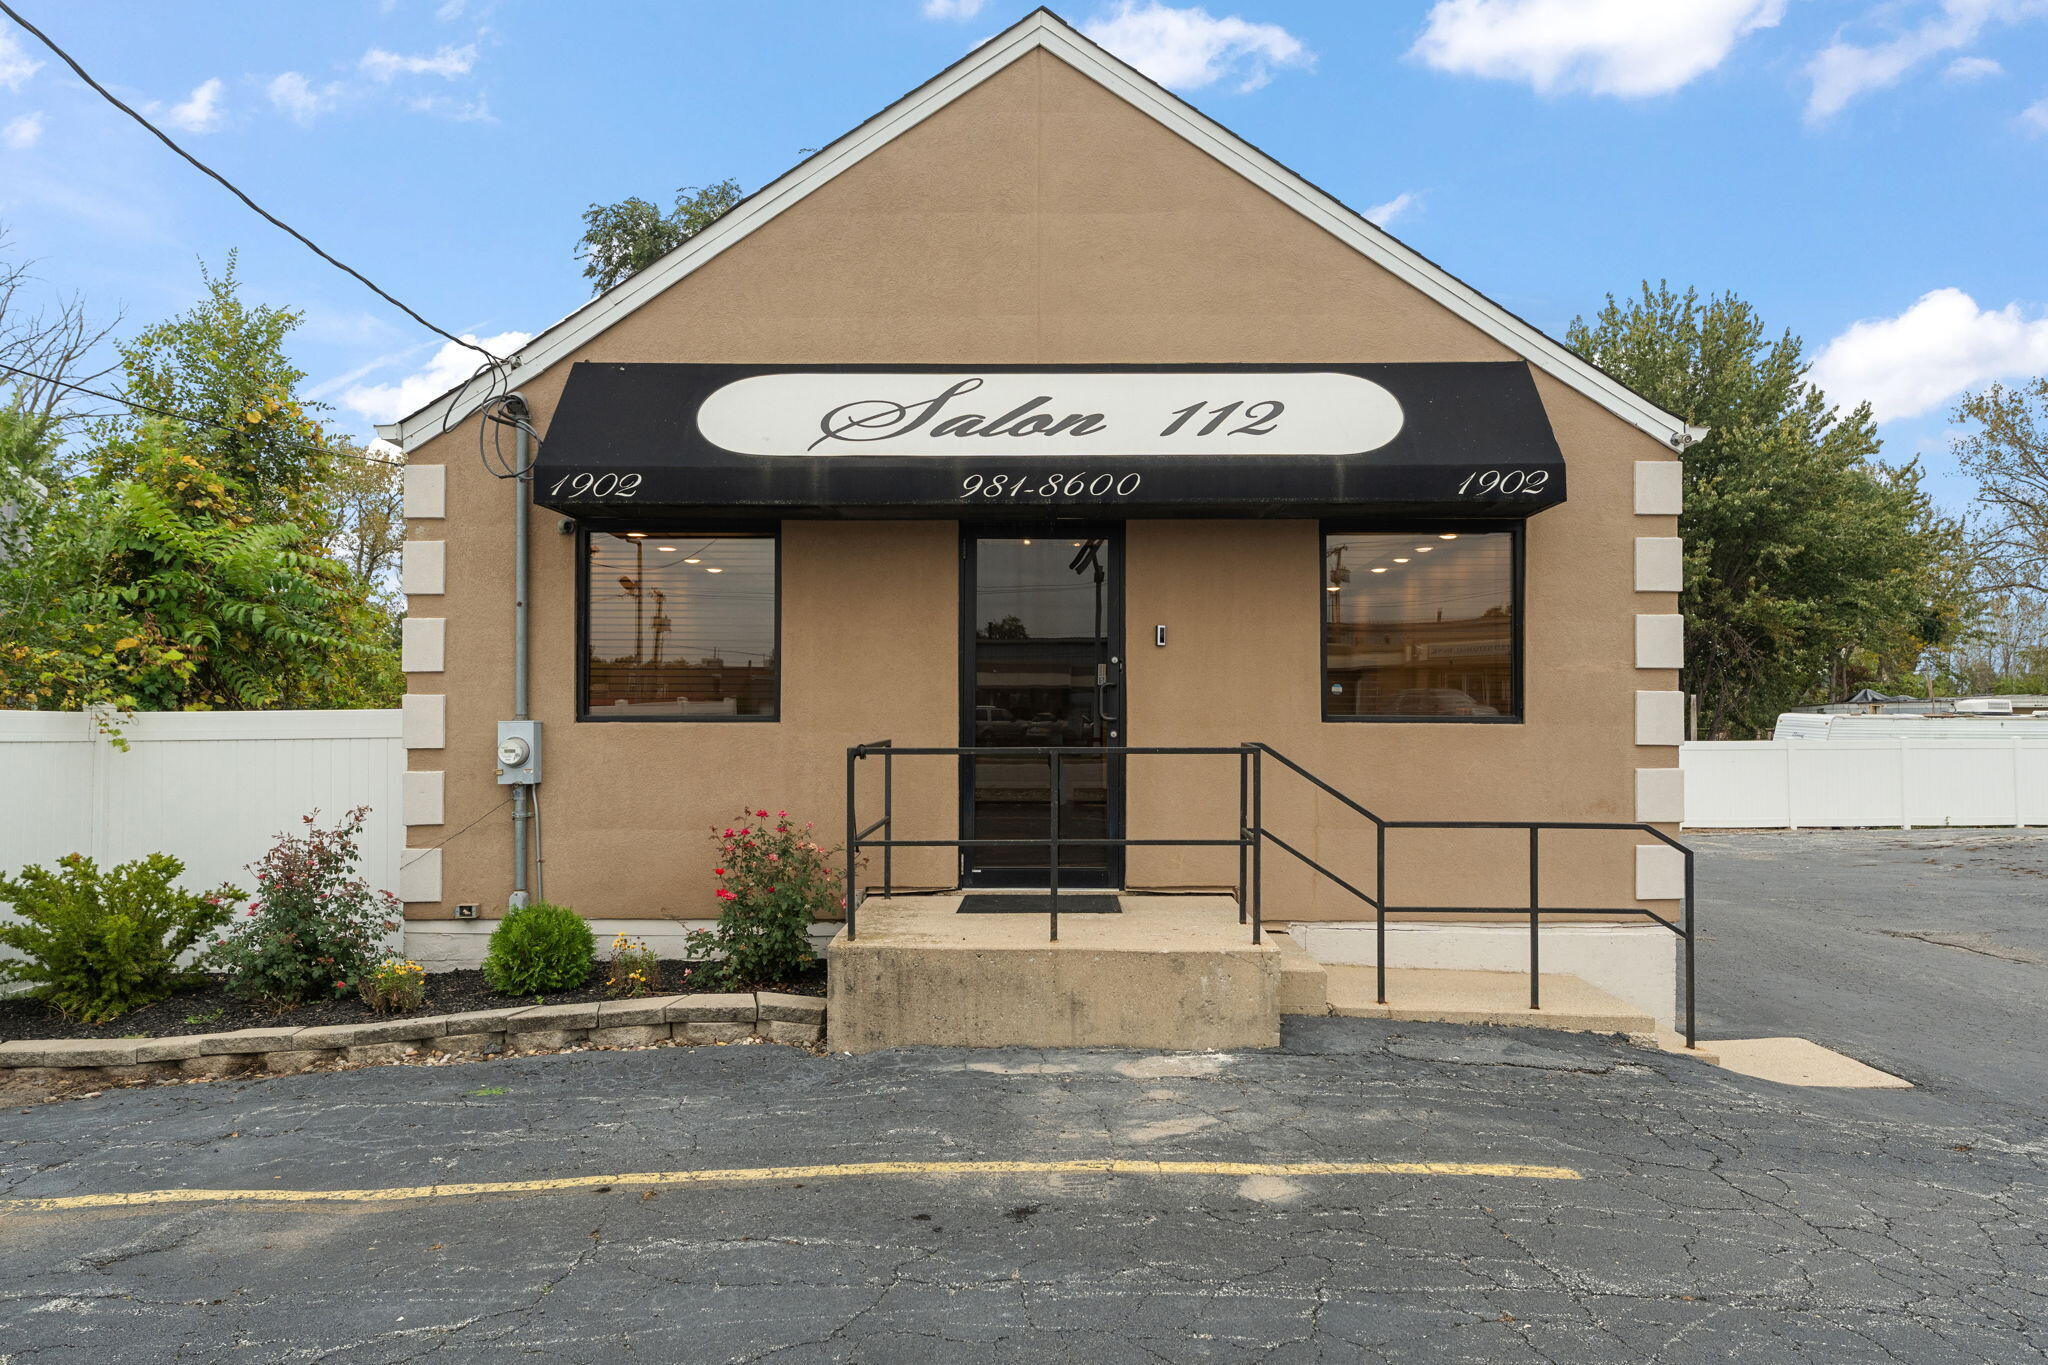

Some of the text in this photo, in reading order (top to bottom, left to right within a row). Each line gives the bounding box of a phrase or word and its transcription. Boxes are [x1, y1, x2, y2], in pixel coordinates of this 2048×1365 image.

[807, 378, 1285, 451] Salon 112
[550, 472, 643, 498] 1902
[960, 472, 1141, 498] 981-8600
[1458, 470, 1549, 495] 1902
